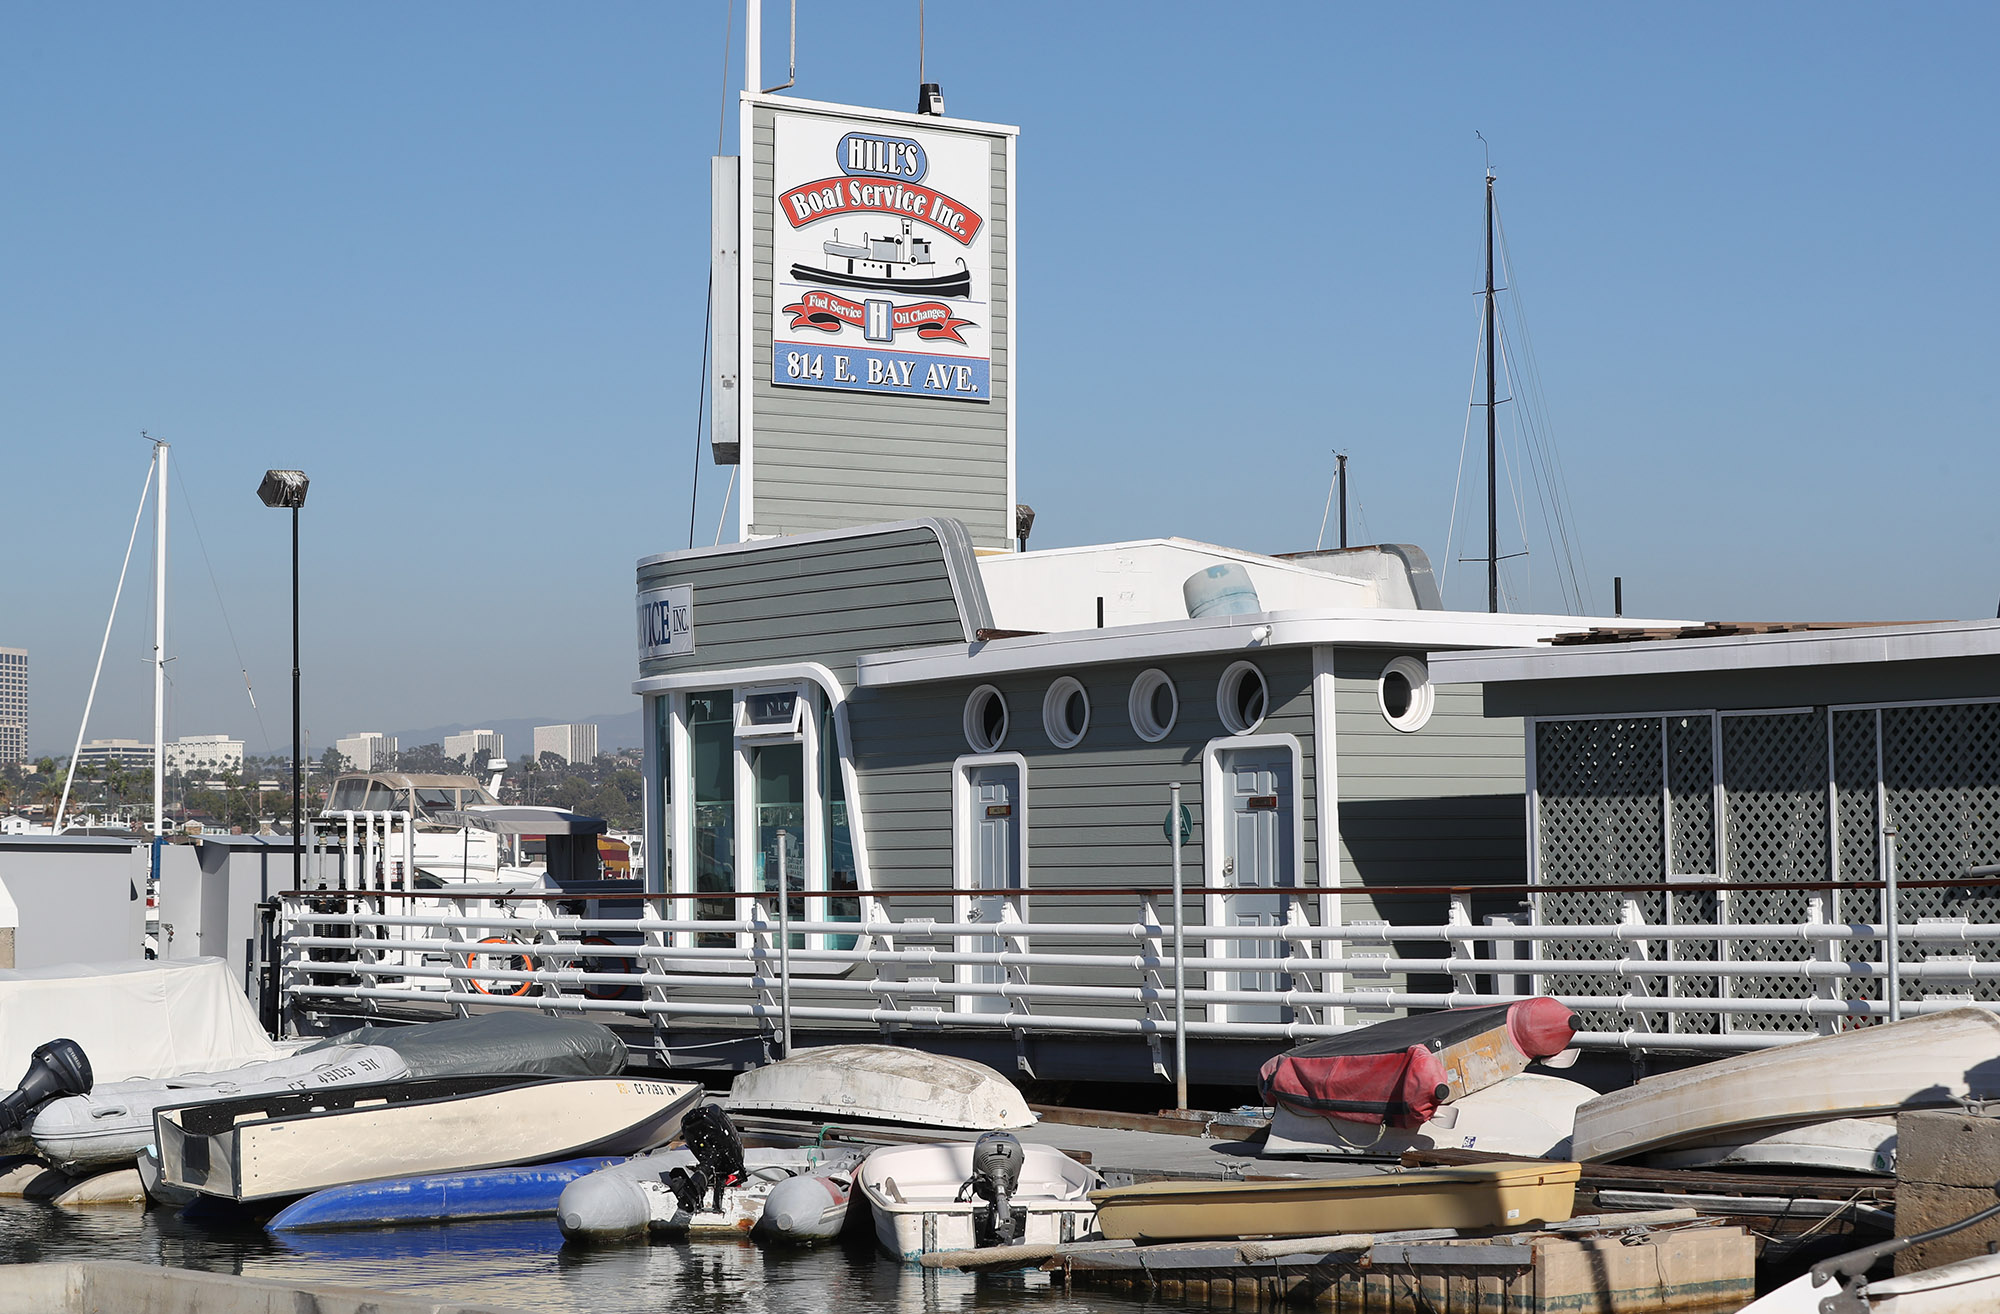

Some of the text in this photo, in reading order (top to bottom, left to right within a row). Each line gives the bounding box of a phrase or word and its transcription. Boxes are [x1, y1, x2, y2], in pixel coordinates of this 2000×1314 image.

[848, 138, 918, 176] HILL'S
[790, 180, 966, 236] Boat Service Inc.
[809, 295, 862, 318] Fuel Service
[870, 302, 888, 338] H
[894, 308, 946, 324] Oil Changes
[787, 352, 979, 392] 814 E. BAY AVE.
